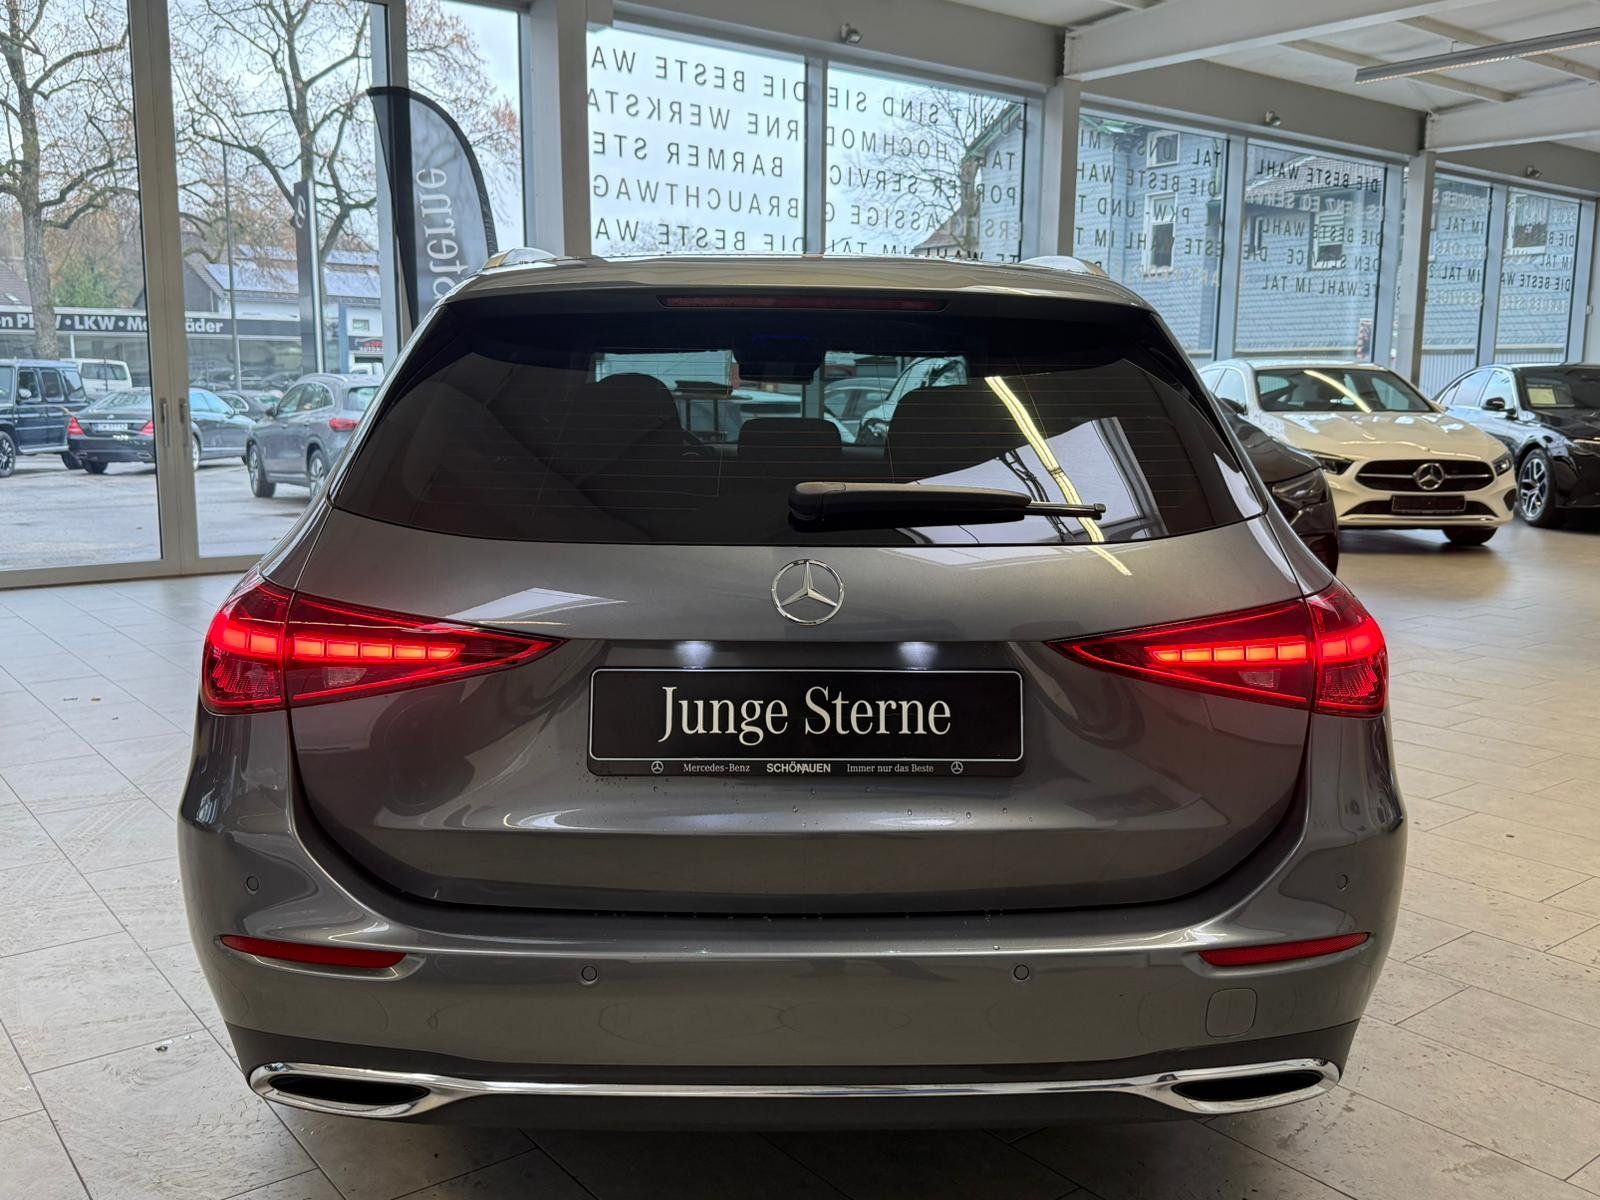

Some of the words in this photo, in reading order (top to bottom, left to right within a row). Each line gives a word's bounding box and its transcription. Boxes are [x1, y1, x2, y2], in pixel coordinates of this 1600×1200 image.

[74, 315, 116, 331] LKW
[658, 686, 789, 746] Junge
[804, 685, 951, 735] Sterne
[683, 763, 751, 773] Mercedes-Benz
[847, 763, 875, 773] Immer
[877, 765, 893, 773] nur
[894, 763, 909, 773] das
[911, 763, 934, 773] Beste
